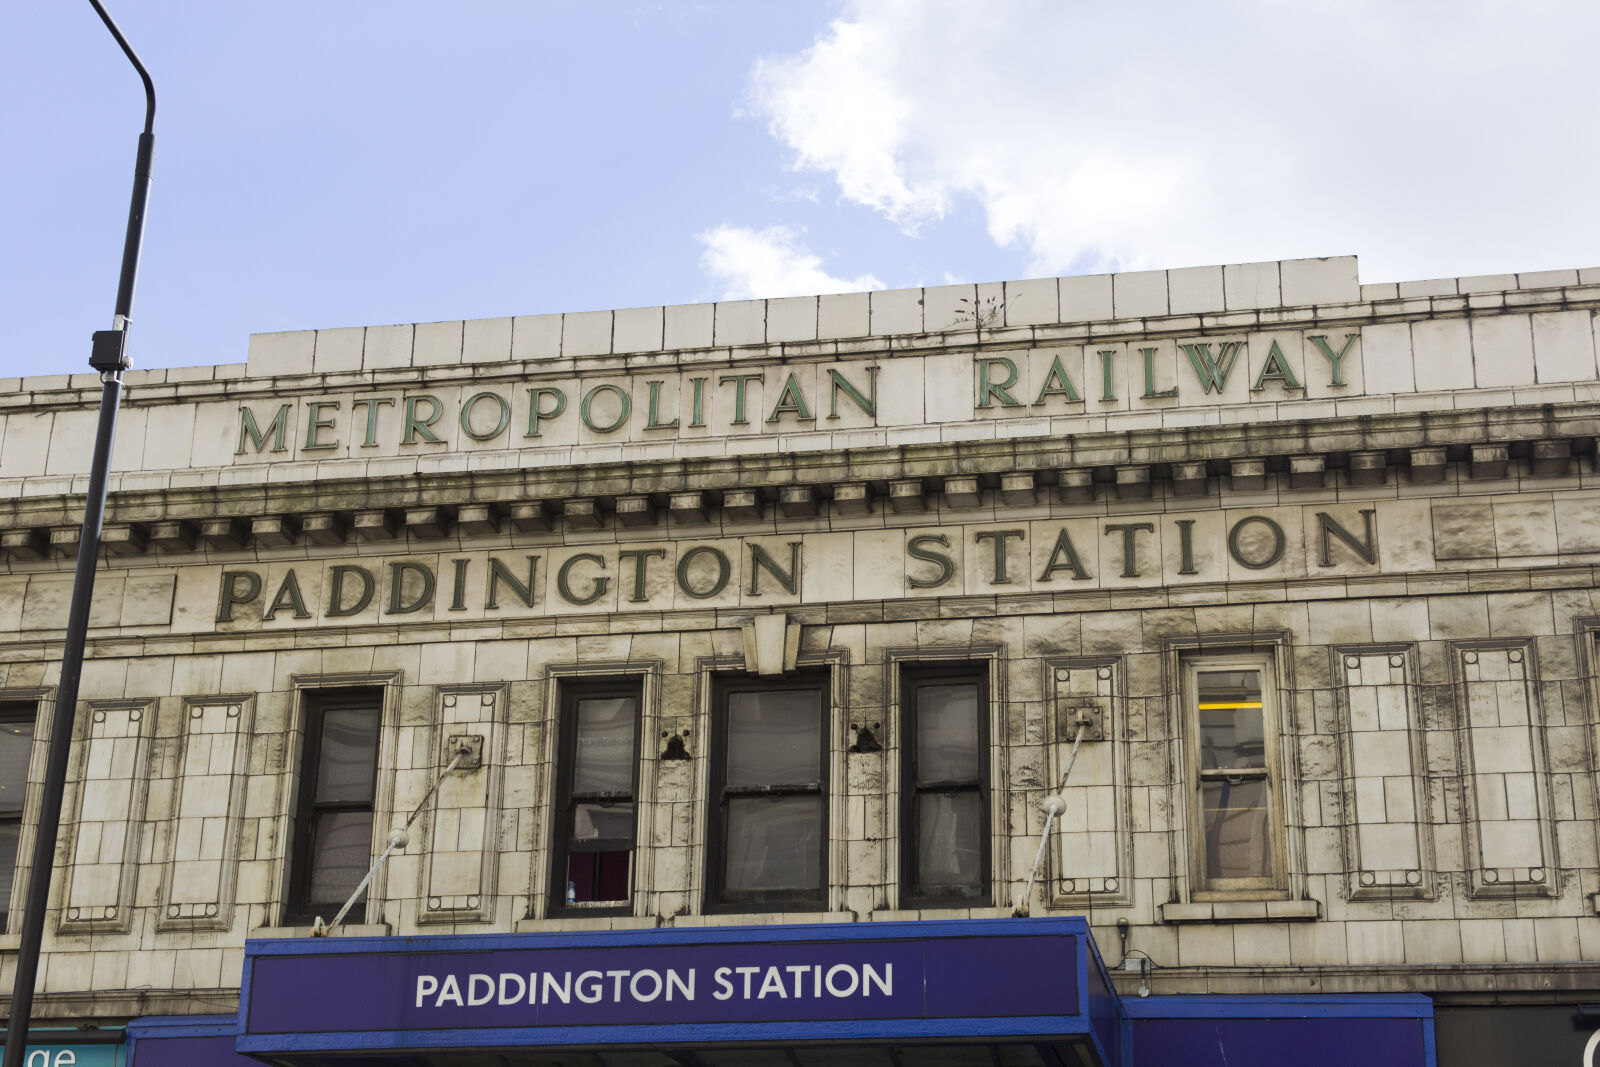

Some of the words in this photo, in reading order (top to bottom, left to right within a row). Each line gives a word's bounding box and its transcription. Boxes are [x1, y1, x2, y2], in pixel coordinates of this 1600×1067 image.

[234, 365, 880, 455] METROPOLITAN
[974, 333, 1361, 410] RAILWAY
[215, 540, 802, 622] PADDINGTON
[906, 508, 1377, 589] STATION
[415, 968, 697, 1008] PADDINGTON
[712, 962, 894, 1000] STATION
